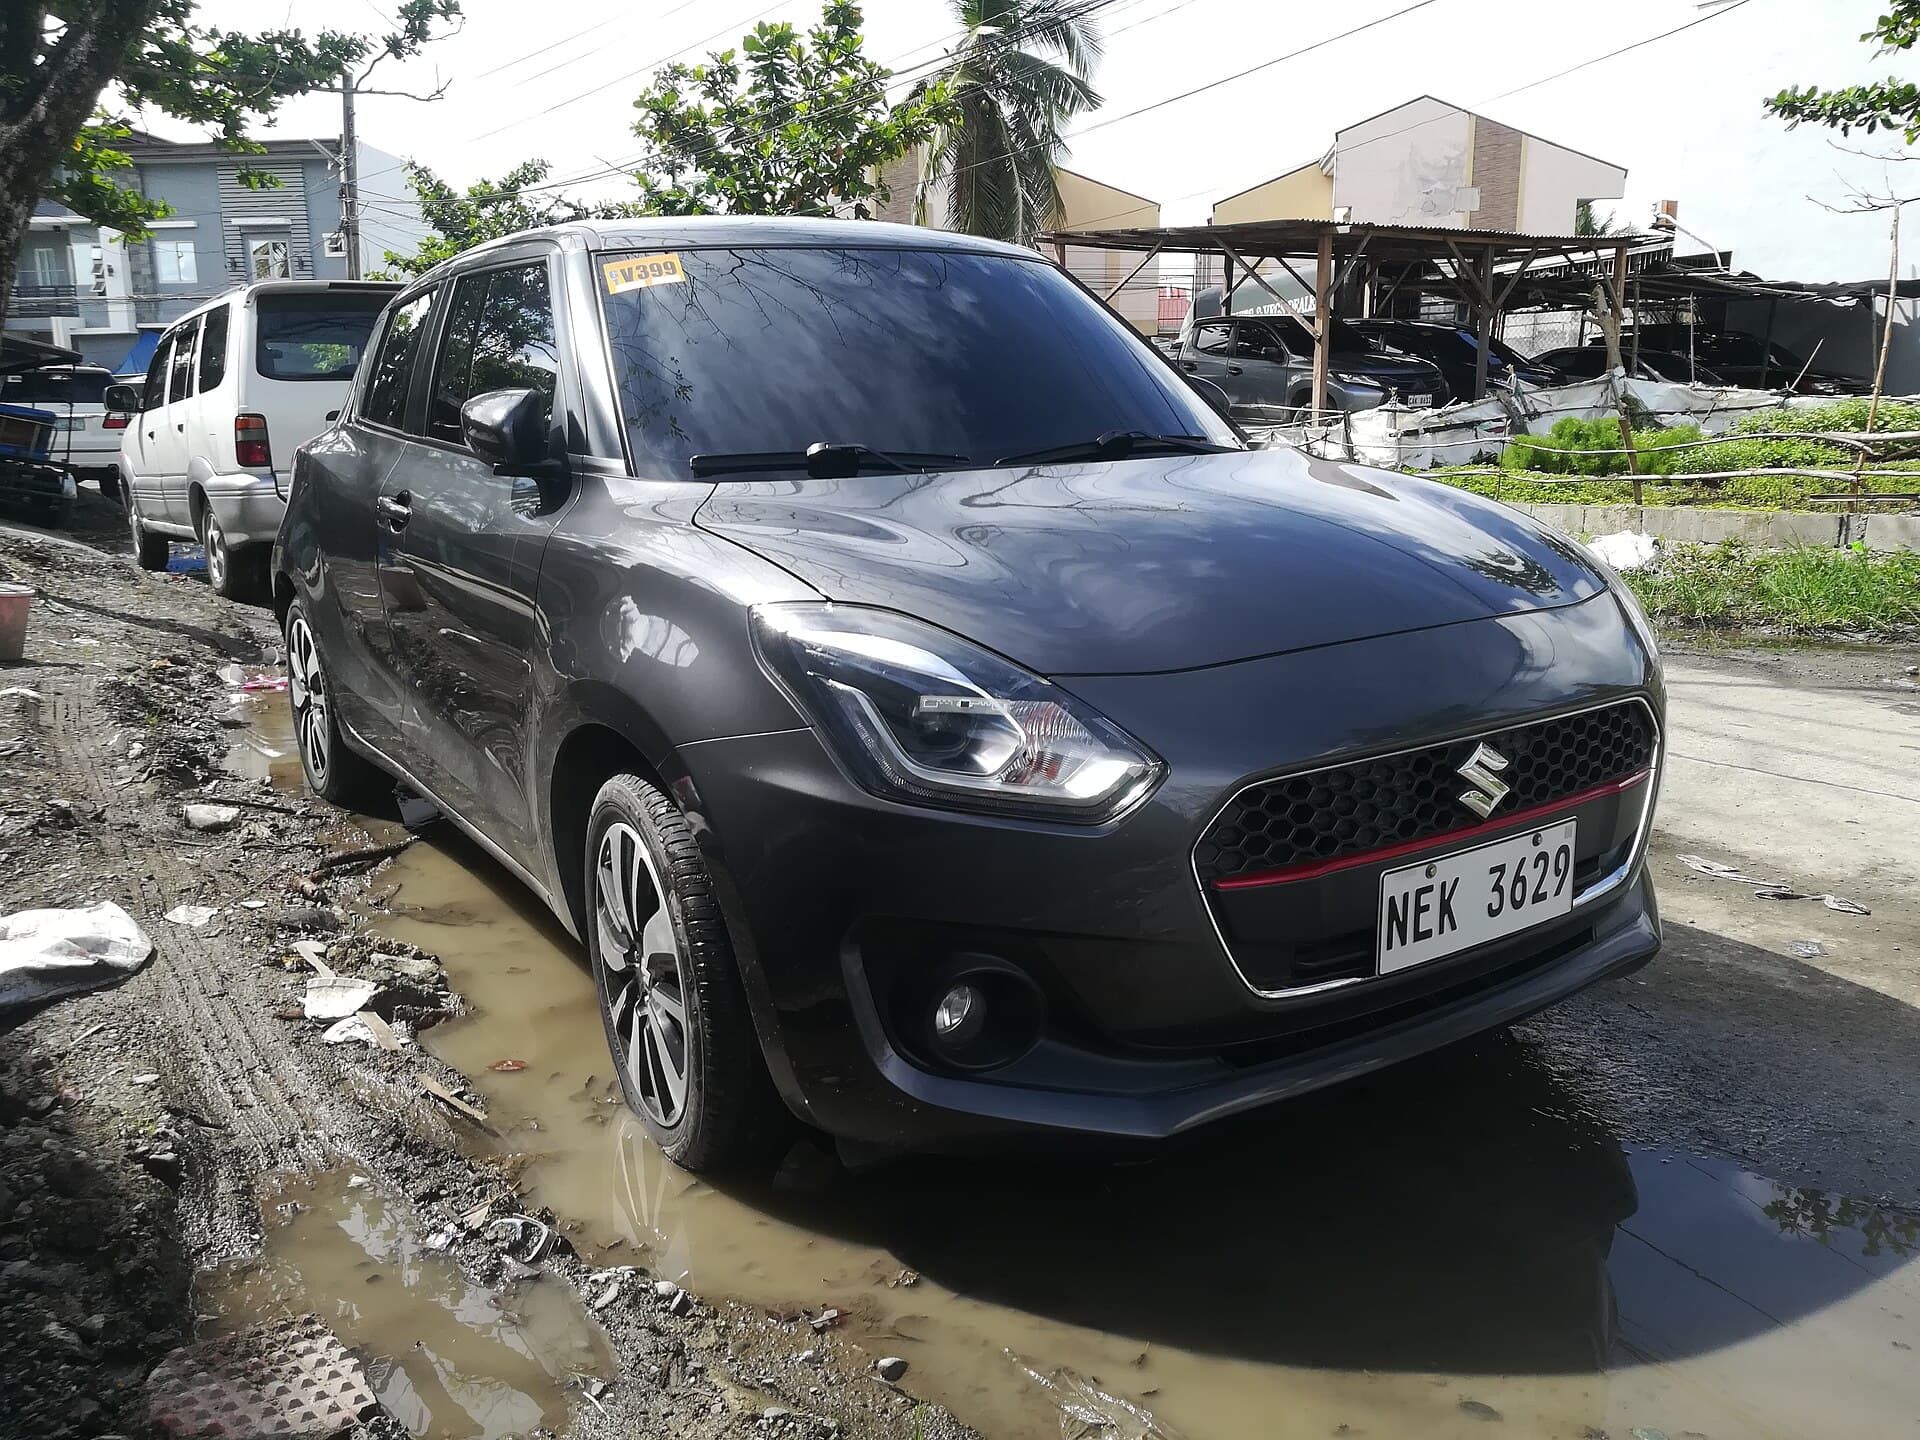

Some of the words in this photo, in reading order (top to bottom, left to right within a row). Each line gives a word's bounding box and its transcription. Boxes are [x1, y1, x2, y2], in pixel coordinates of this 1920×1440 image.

[620, 261, 677, 283] V399
[1386, 876, 1460, 950] NEK
[1487, 844, 1571, 918] 3629
